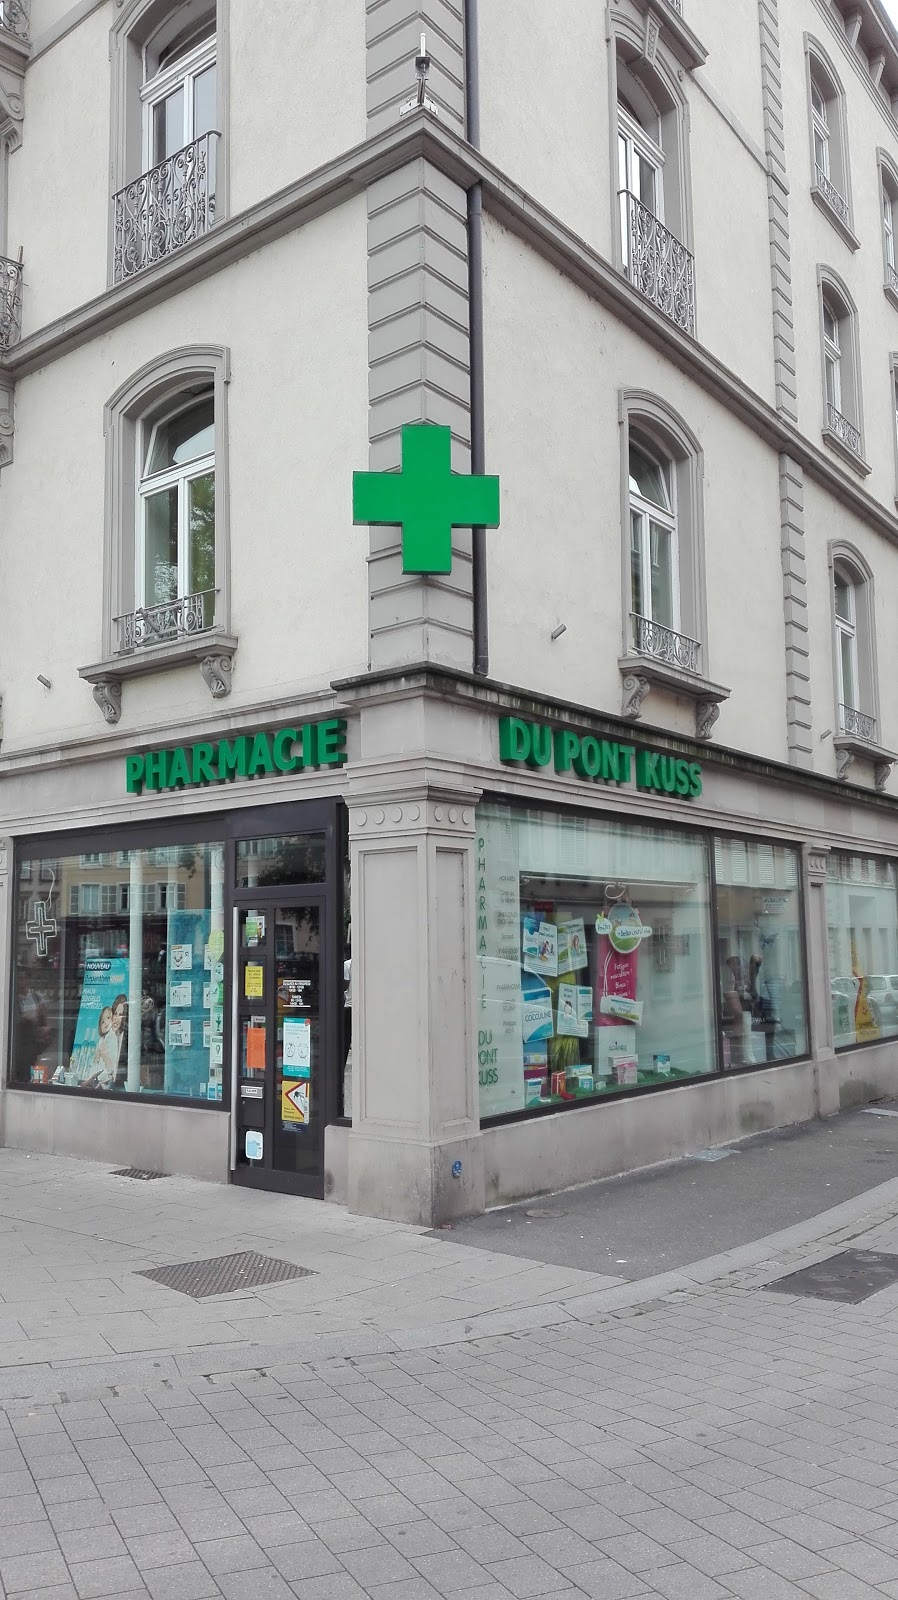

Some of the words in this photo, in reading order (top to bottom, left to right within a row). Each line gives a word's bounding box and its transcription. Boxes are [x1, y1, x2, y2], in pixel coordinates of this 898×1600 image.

[126, 719, 348, 793] PHARMACIE
[499, 717, 552, 767] DU
[554, 730, 636, 779] PONT
[636, 750, 702, 798] KUSS
[478, 837, 488, 1009] PHARMACIE
[86, 962, 110, 970] NOUVEAU
[614, 963, 629, 972] Fatigue
[525, 1010, 552, 1022] COCCULINE
[478, 1029, 492, 1046] DU
